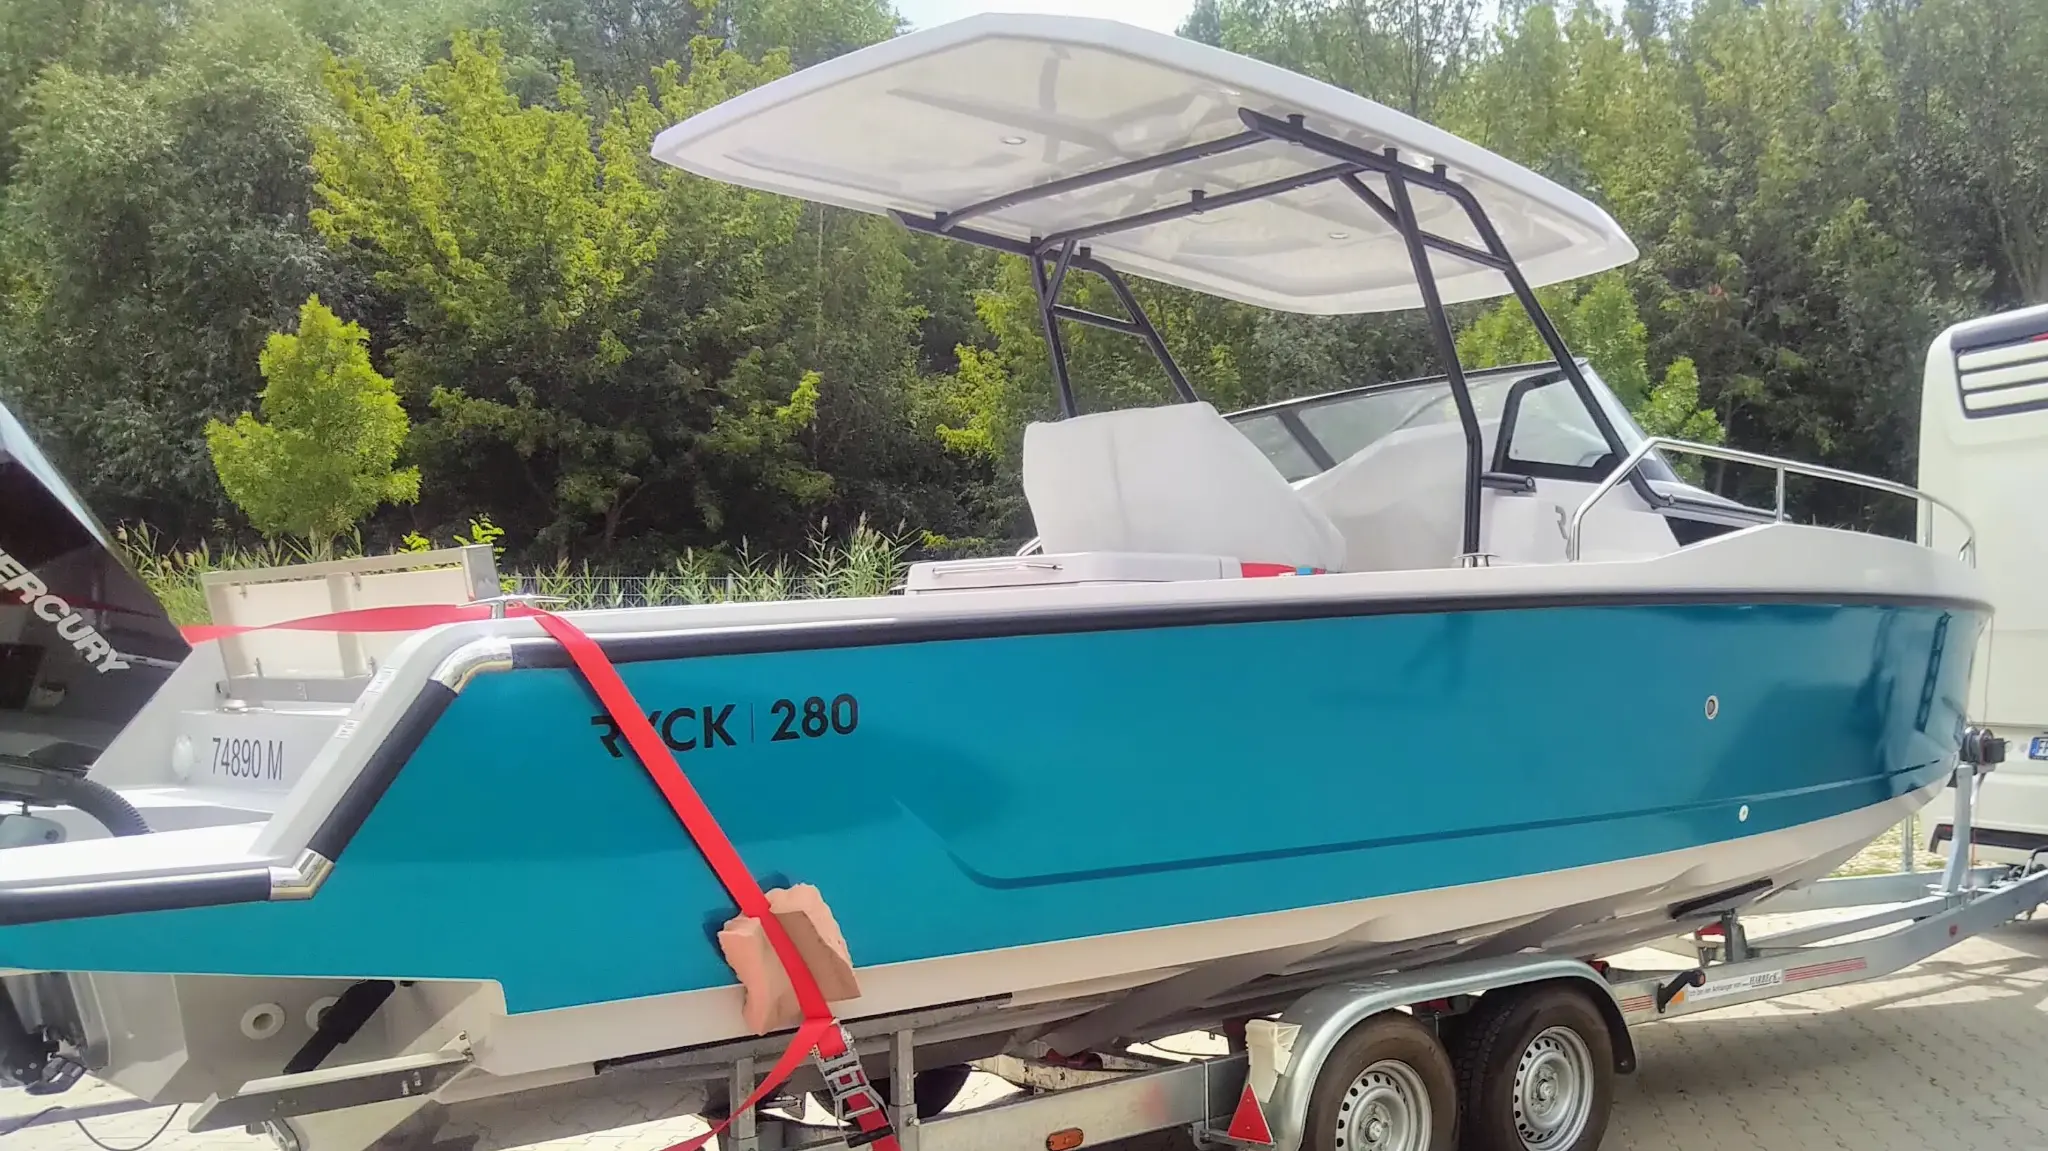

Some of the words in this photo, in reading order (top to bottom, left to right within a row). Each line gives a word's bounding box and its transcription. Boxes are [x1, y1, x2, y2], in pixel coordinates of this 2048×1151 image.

[0, 548, 131, 674] ERCURY
[590, 703, 737, 758] RCK
[770, 693, 859, 742] 280
[212, 736, 262, 779] 74890
[267, 739, 283, 781] M
